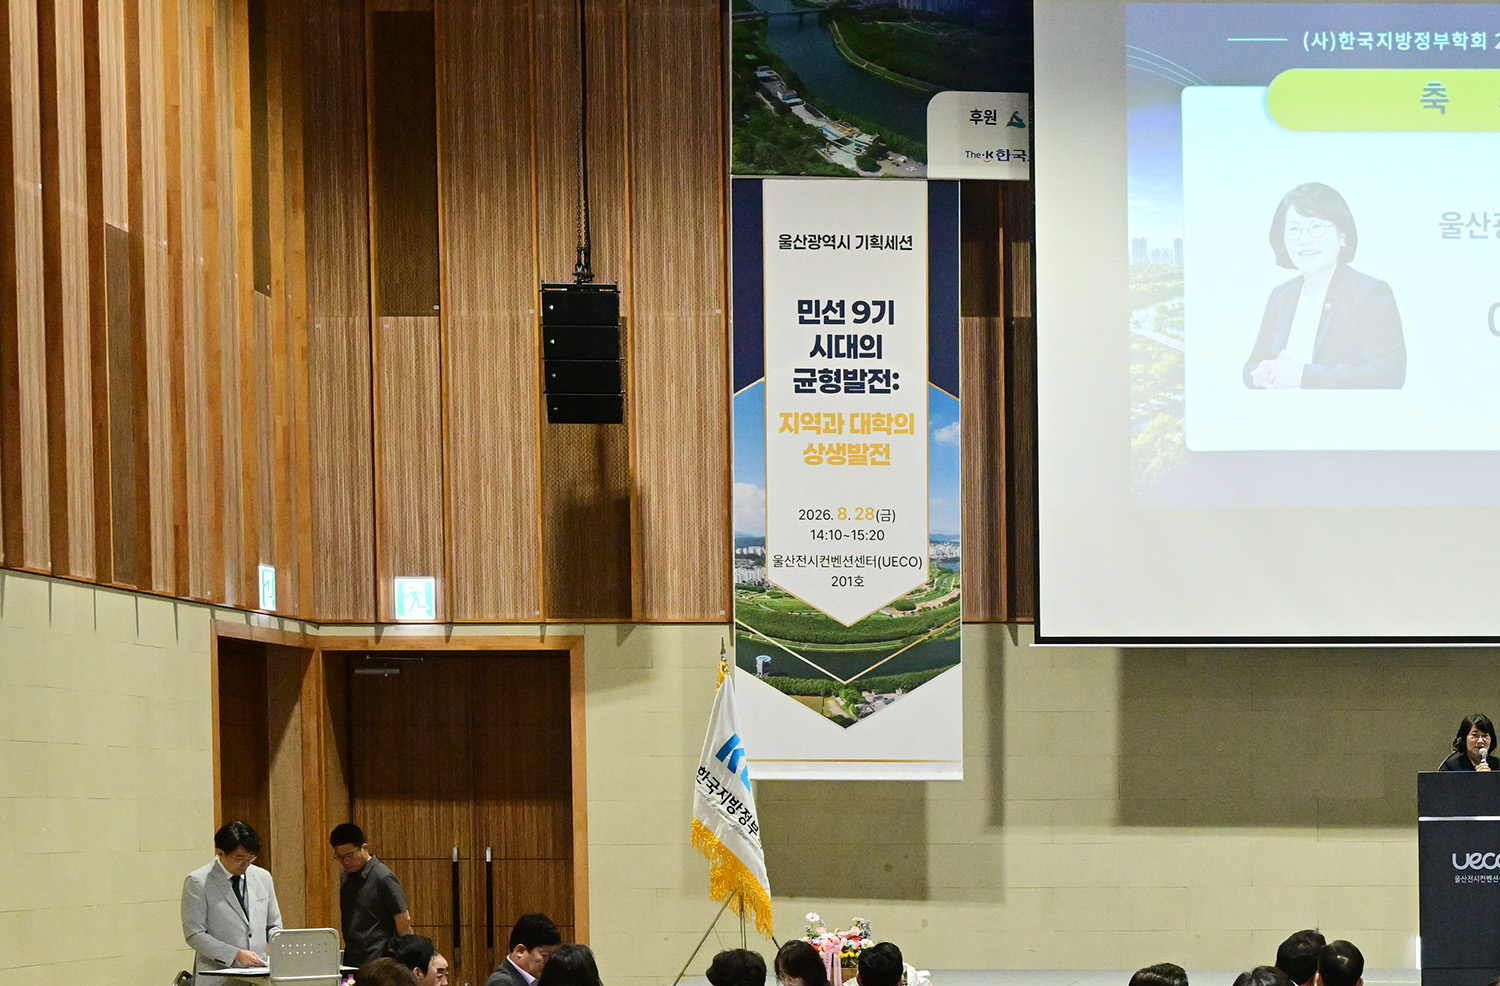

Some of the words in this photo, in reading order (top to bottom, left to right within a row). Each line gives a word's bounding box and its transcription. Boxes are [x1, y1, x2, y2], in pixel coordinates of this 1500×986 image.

[1303, 31, 1487, 52] (사)한국지방정부학회
[1419, 80, 1450, 115] 축
[969, 108, 997, 126] 후원
[995, 148, 1030, 162] 한국
[778, 233, 851, 251] 울산광역시
[855, 234, 913, 251] 기획세션
[797, 299, 846, 325] 민선
[851, 299, 895, 326] 9기
[809, 333, 883, 360] 시대의
[793, 367, 900, 395] 균형발전:
[778, 411, 846, 436] 지역과
[849, 411, 915, 436] 대학의
[802, 442, 891, 466] 상생발전
[798, 508, 834, 521] 2026.
[810, 529, 885, 541] 14:10~15:20
[772, 554, 923, 571] 울산전시컨벤션센터(UECO)
[831, 575, 865, 588] 201호
